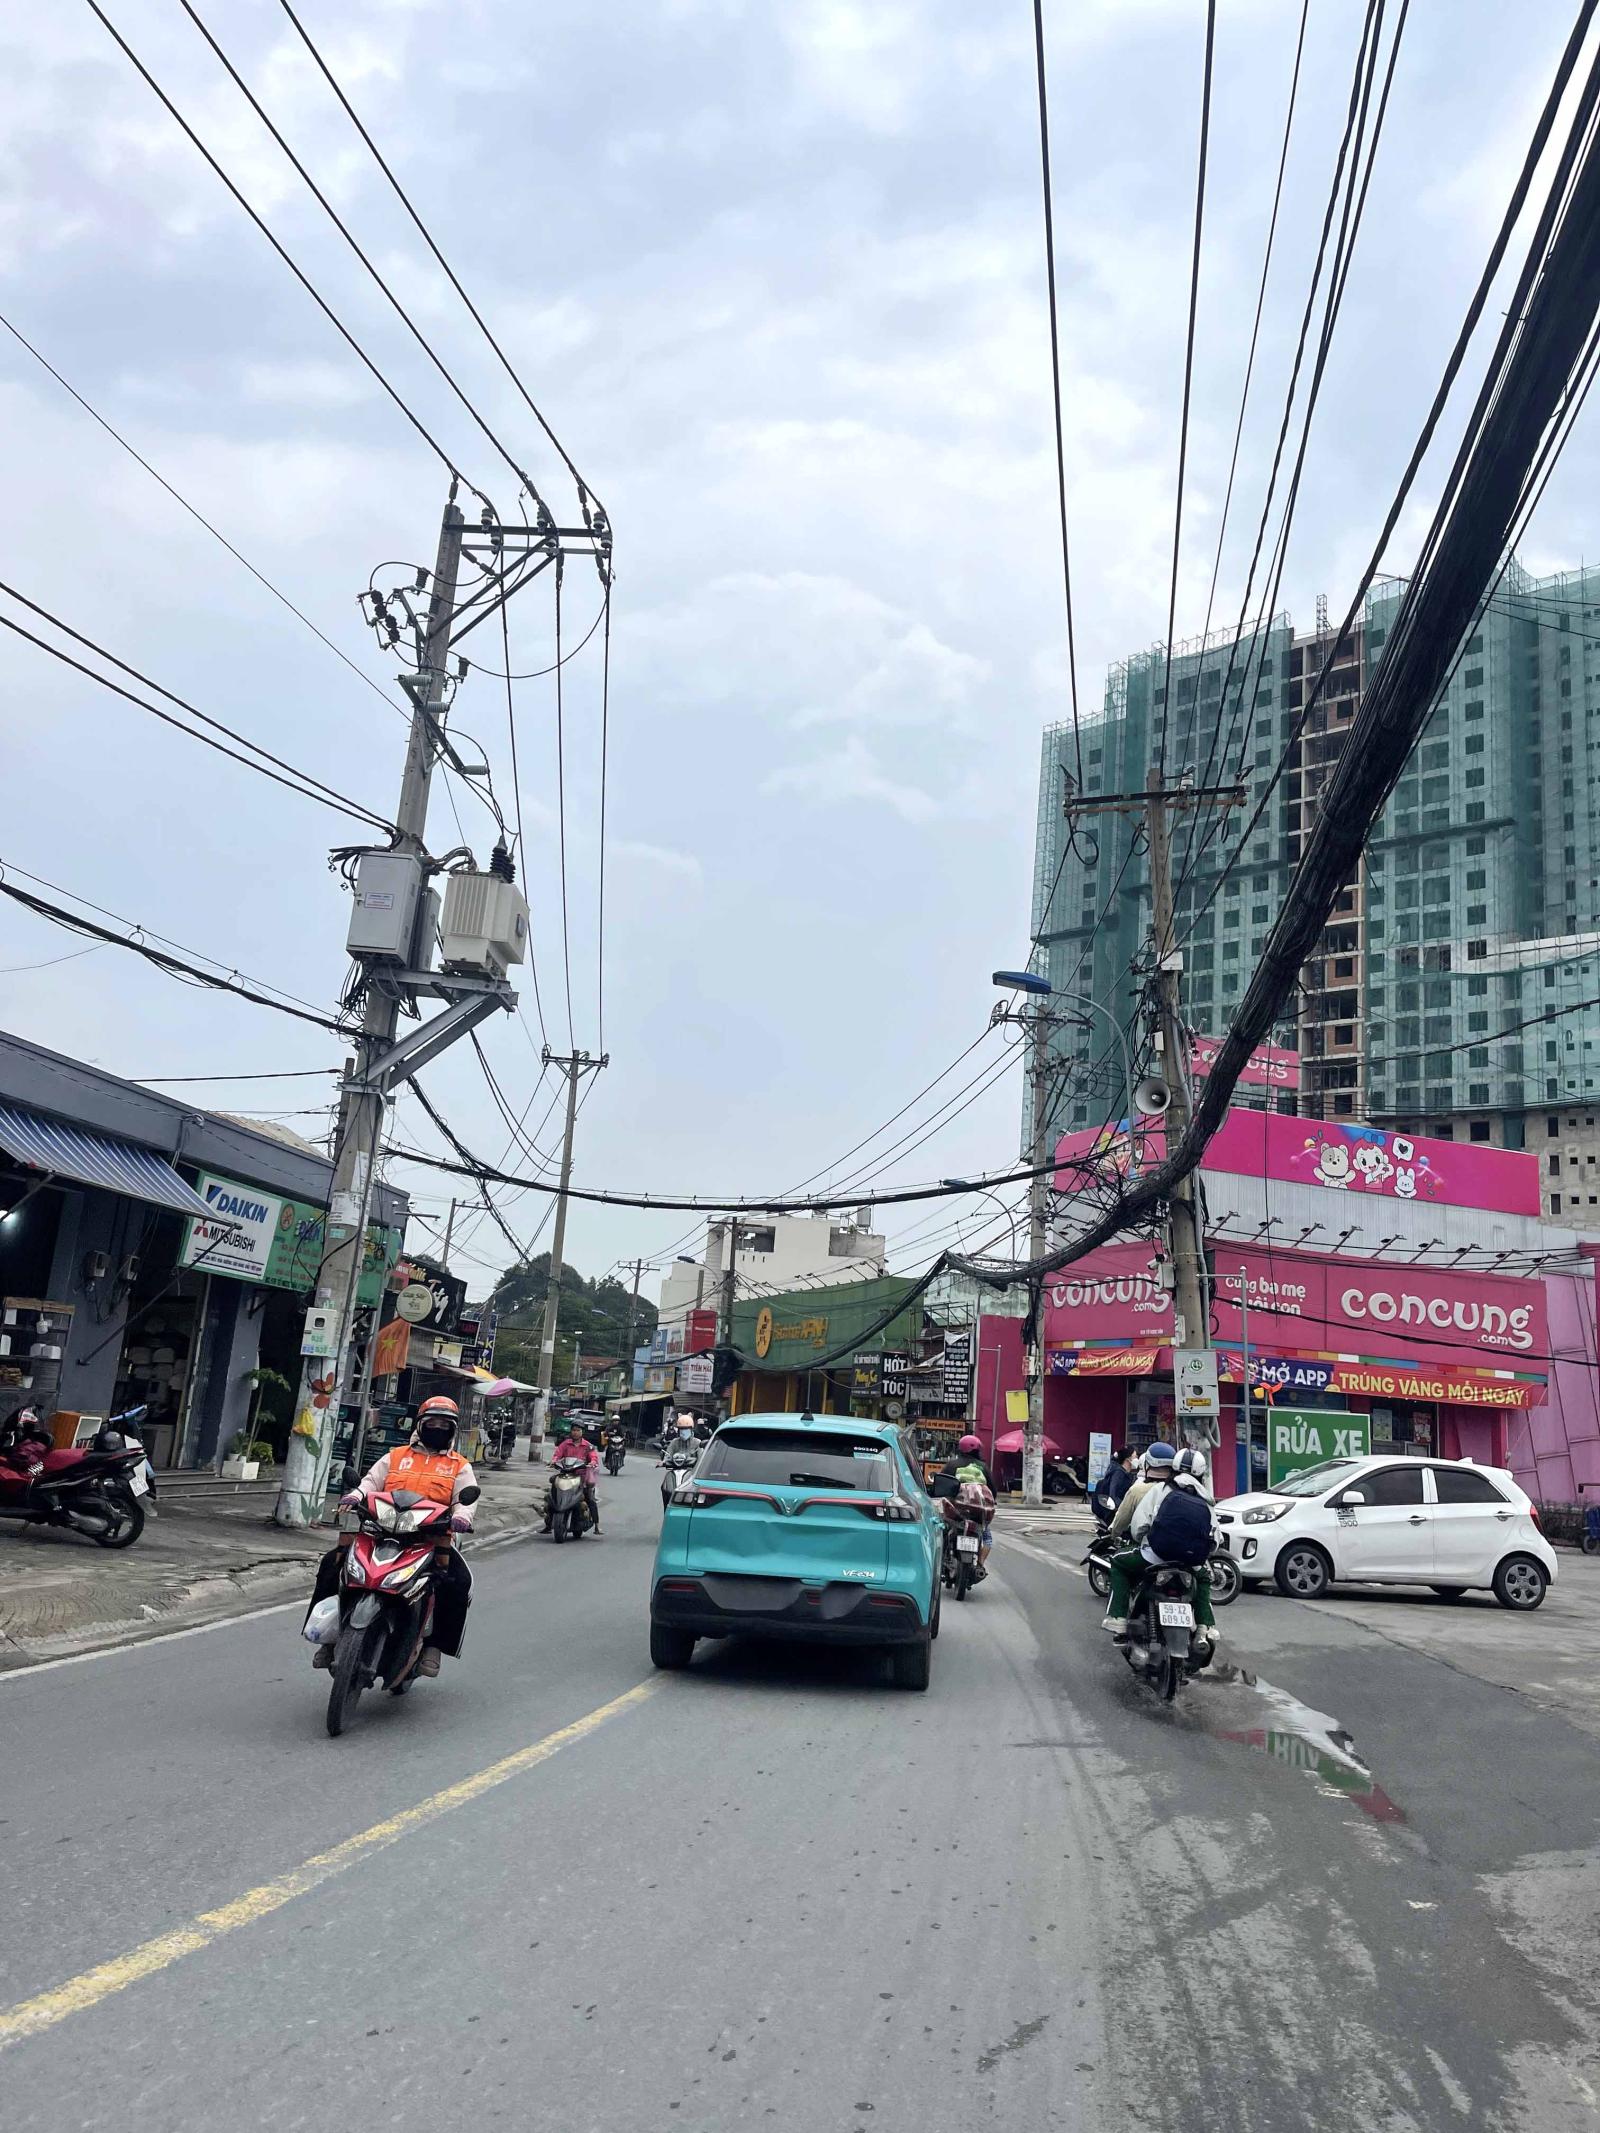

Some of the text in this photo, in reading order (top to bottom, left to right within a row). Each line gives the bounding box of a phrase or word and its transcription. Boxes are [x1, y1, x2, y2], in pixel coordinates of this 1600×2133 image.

[216, 1193, 269, 1224] DAIKIN
[208, 1225, 257, 1253] MITSUBISHI
[1260, 1276, 1279, 1295] ba
[1281, 1283, 1306, 1302] mẹ
[1340, 1288, 1535, 1350] concung
[1476, 1334, 1509, 1346] .com
[882, 1376, 905, 1396] TÓC
[1261, 1362, 1290, 1384] MỞ
[1294, 1369, 1328, 1387] APP
[1339, 1371, 1396, 1394] TRÚNG
[1398, 1377, 1444, 1398] VÀNG
[1481, 1386, 1526, 1406] NGÀY
[1275, 1415, 1364, 1457] RỬA XE
